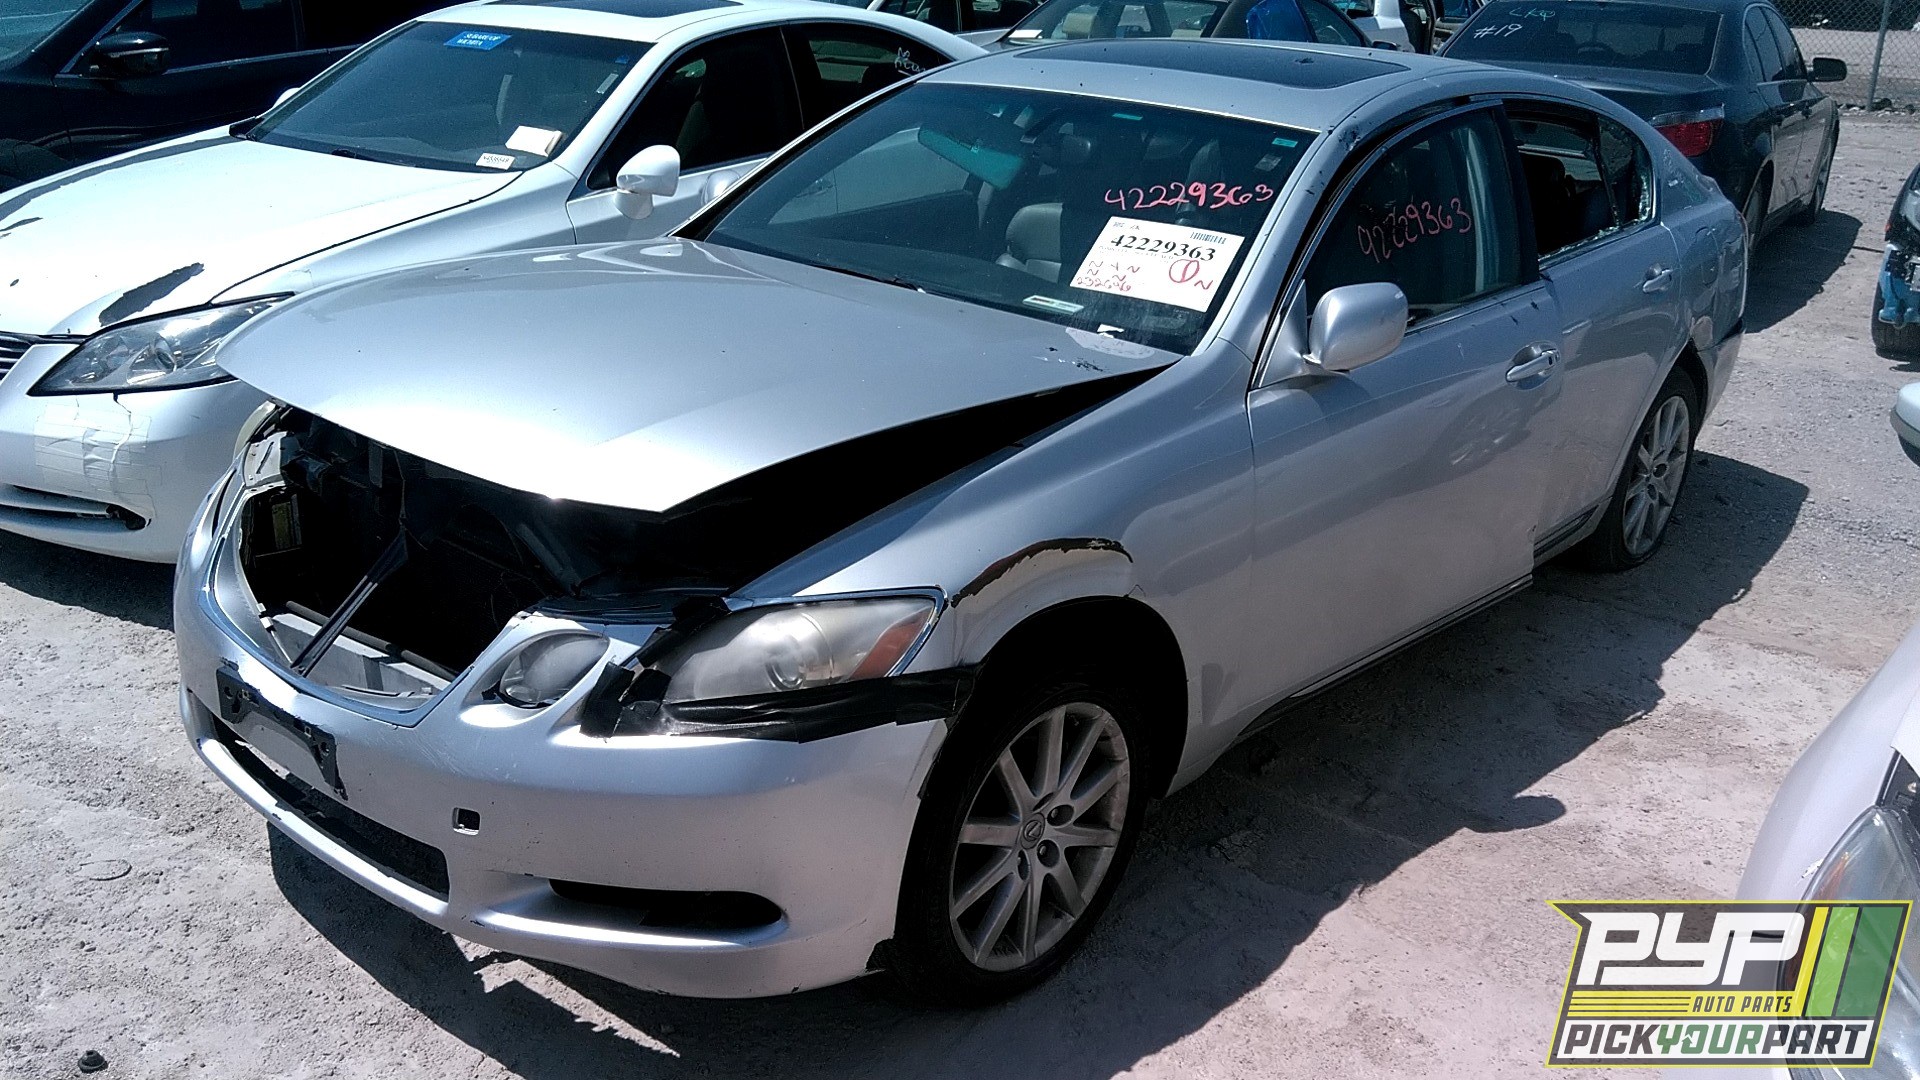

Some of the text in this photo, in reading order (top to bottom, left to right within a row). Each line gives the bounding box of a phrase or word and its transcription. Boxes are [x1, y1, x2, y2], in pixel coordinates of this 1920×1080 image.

[1473, 23, 1523, 39] #19
[1104, 181, 1275, 211] 42229363
[1110, 233, 1217, 262] 42229363
